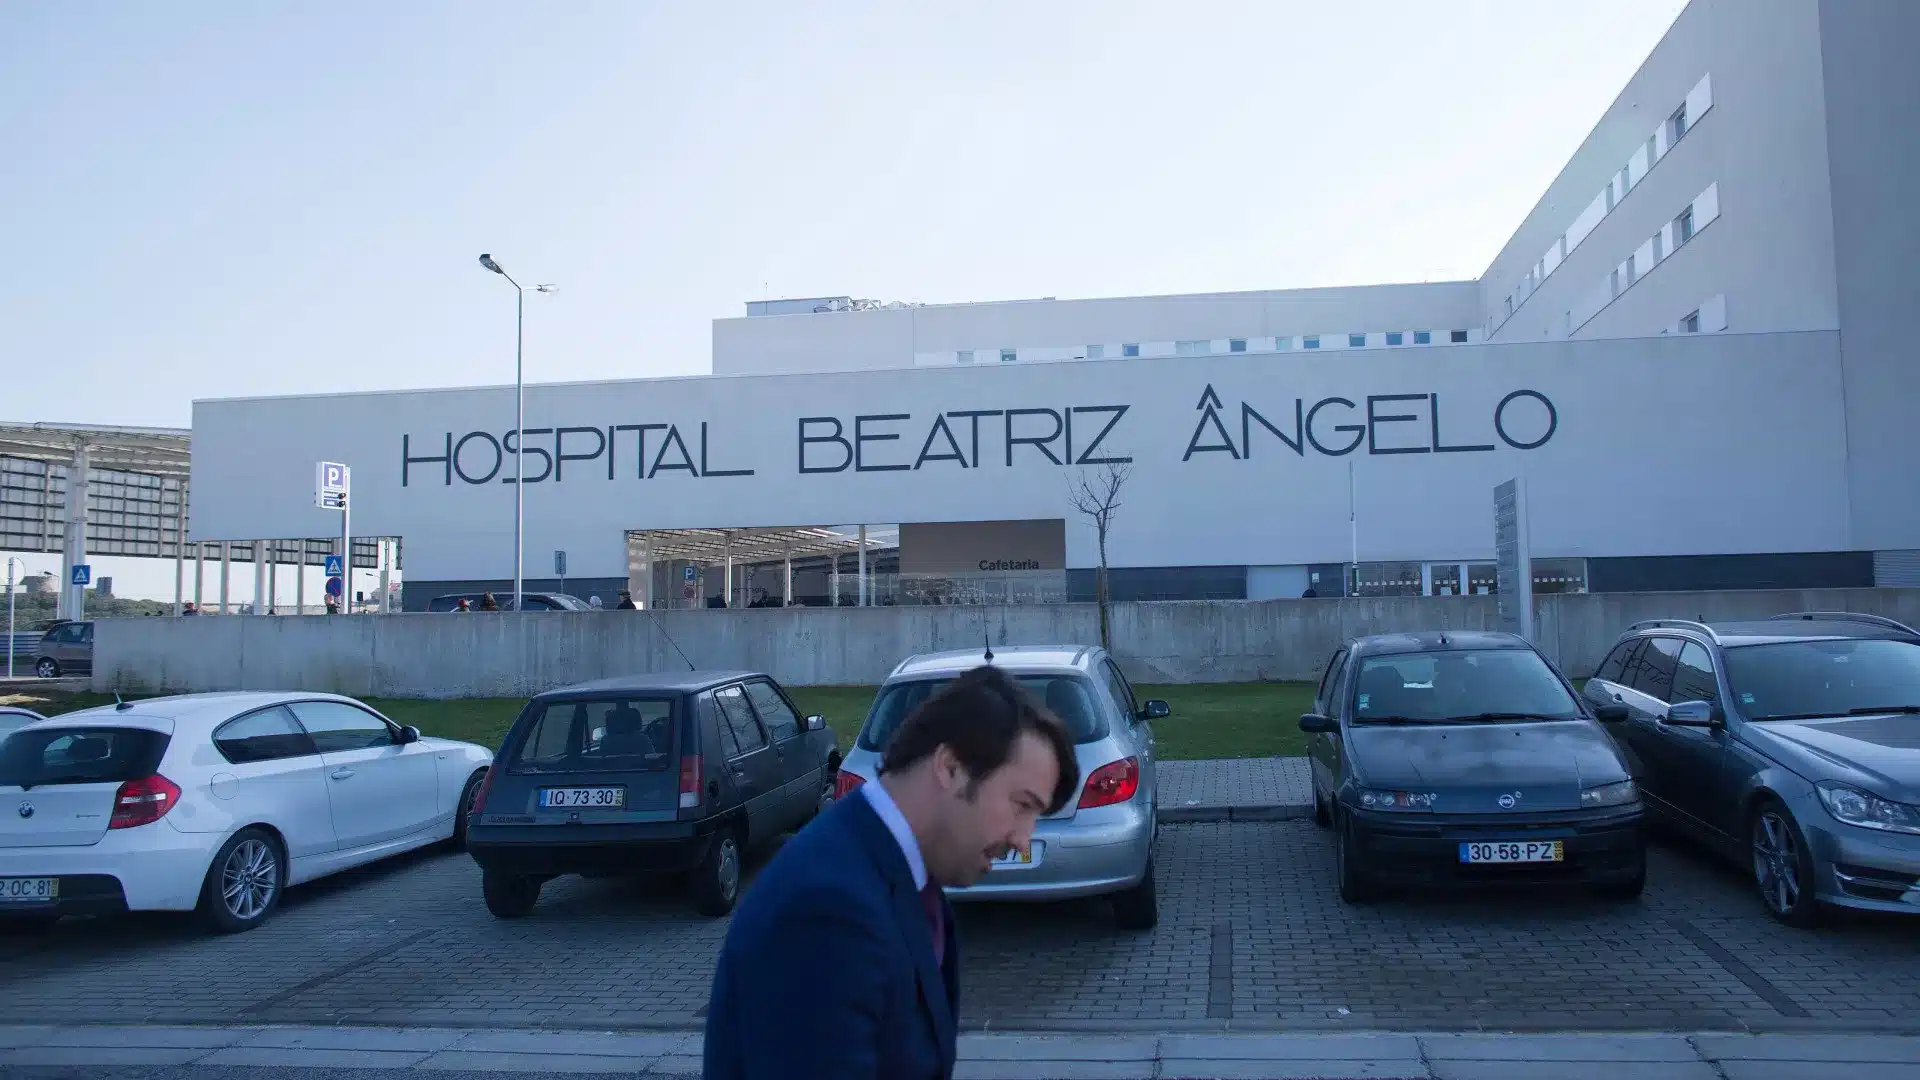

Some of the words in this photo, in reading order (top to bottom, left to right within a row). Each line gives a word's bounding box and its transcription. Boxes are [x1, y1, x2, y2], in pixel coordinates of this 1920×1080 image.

[402, 421, 755, 488] HOSPITAL
[798, 404, 1133, 474] BEATRIZ
[1181, 383, 1558, 462] ÂNGELO
[978, 558, 1040, 571] Cafetaria
